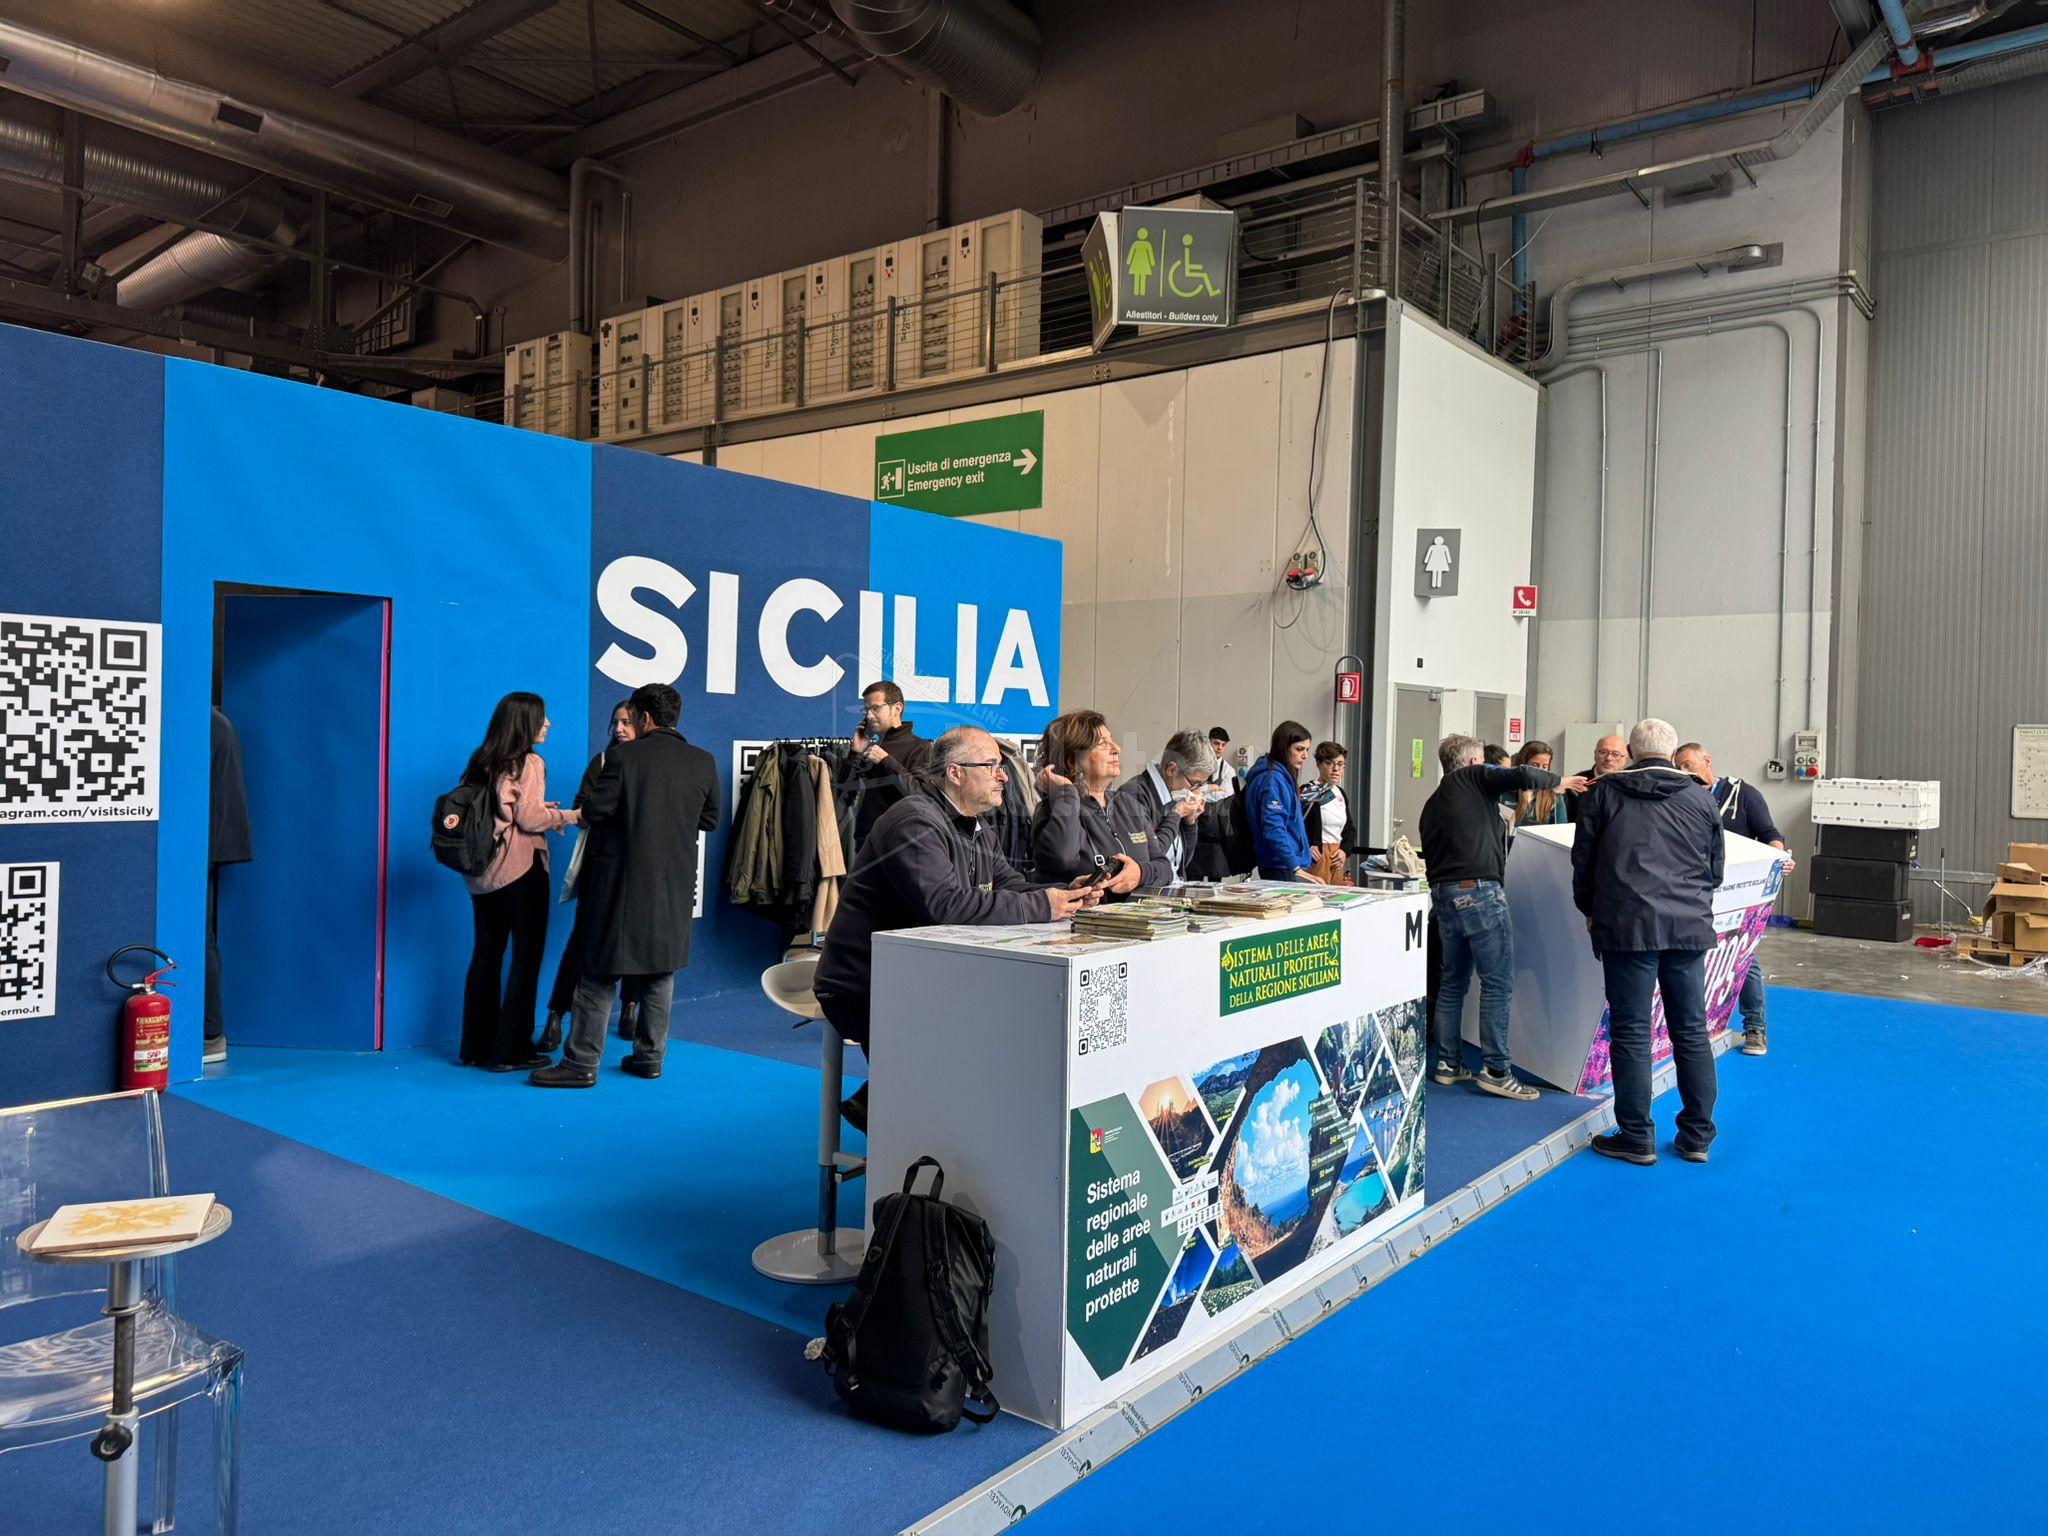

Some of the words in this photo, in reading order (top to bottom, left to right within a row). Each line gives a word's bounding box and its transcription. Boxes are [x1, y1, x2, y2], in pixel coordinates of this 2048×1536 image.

[1125, 310, 1162, 320] Allestitori
[1168, 311, 1200, 321] Builders
[1202, 313, 1219, 323] only
[907, 461, 938, 475] Uscita
[941, 458, 950, 471] di
[953, 451, 1011, 469] emergenza
[907, 475, 963, 492] Emergency
[965, 471, 985, 484] exit
[595, 555, 1050, 708] SICILIA
[0, 806, 154, 820] agram.com/visitsicily
[1405, 910, 1422, 951] M
[1223, 943, 1273, 971] SISTEMA
[1276, 938, 1304, 958] DELLE
[1306, 933, 1329, 951] AREE
[1230, 965, 1280, 989] NATURALI
[1284, 951, 1330, 976] PROTETTE
[1230, 990, 1254, 1008] DELLA
[1256, 978, 1297, 1001] REGIONE
[1299, 967, 1340, 990] SICILIANA
[0, 1005, 40, 1016] ermo.it
[1087, 1169, 1141, 1205] Sistema
[1087, 1191, 1148, 1233] regionale
[1087, 1231, 1120, 1261] delle
[1122, 1218, 1151, 1245] aree
[1086, 1248, 1137, 1290] naturali
[1085, 1277, 1140, 1322] protette
[988, 1489, 1013, 1517] NOVACEL
